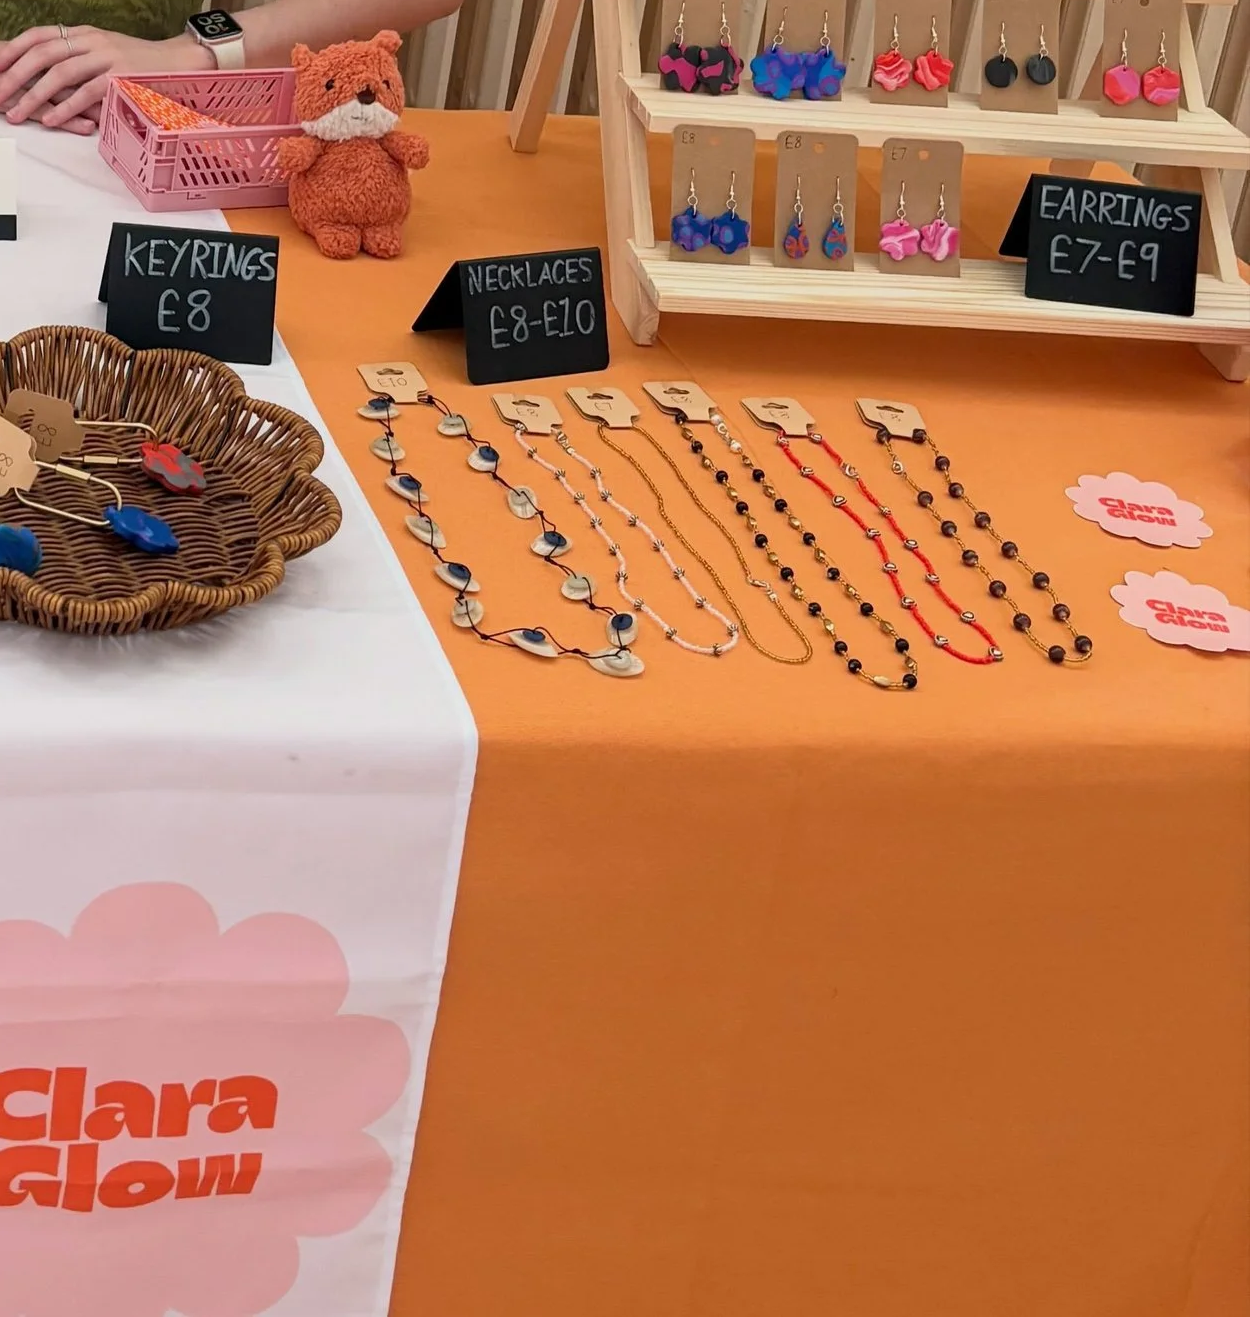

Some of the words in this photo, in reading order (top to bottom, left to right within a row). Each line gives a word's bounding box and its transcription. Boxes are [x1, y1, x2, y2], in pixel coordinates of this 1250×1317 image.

[1040, 185, 1193, 232] EARRINGS
[125, 232, 277, 281] KEYRINGS
[468, 257, 593, 295] NECKLACES
[1050, 234, 1160, 283] £7-£9
[157, 288, 212, 333] £8
[490, 297, 596, 349] £8-£10
[1098, 497, 1174, 516] Clara
[1107, 508, 1177, 527] Glow
[1146, 599, 1227, 623] Clara
[1154, 612, 1230, 634] Glow
